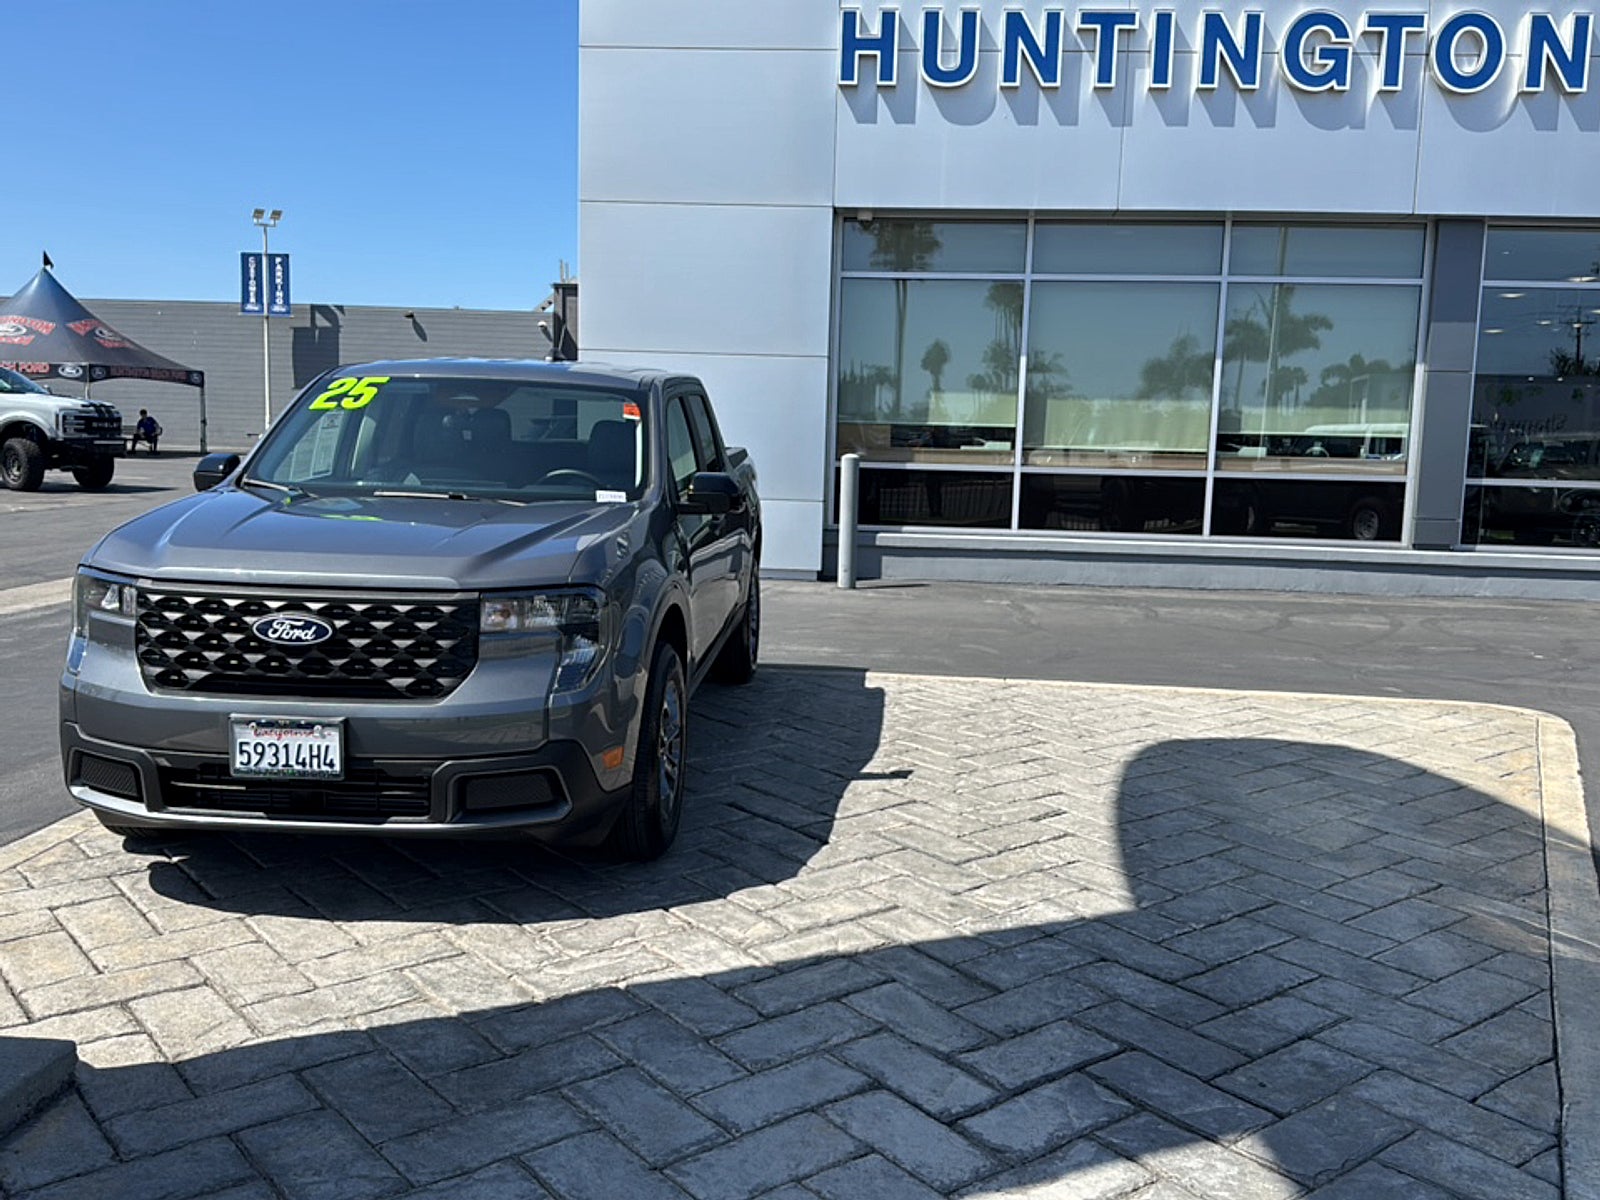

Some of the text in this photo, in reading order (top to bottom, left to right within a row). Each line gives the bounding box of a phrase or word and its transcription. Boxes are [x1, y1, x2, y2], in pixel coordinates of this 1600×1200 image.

[837, 7, 1595, 94] HUNTINGTON
[275, 256, 283, 304] PARKING
[19, 361, 50, 373] FORD
[308, 376, 391, 410] 25
[267, 618, 316, 640] Ford
[238, 741, 335, 769] 59314H4
